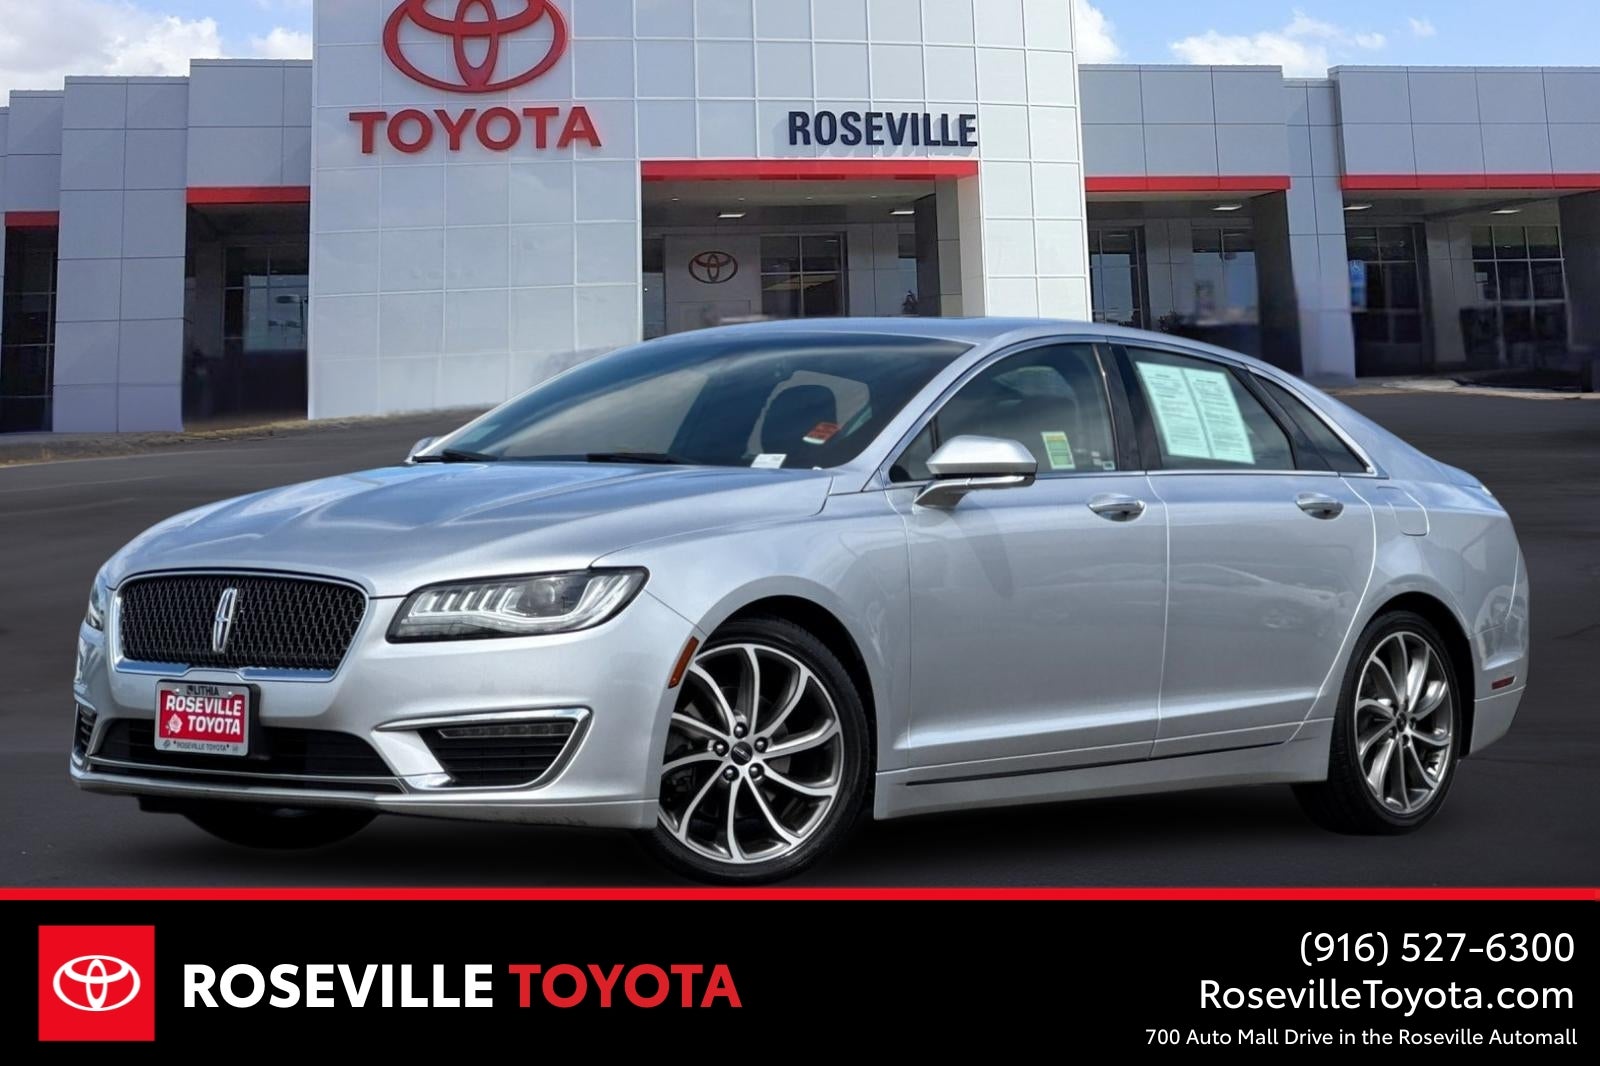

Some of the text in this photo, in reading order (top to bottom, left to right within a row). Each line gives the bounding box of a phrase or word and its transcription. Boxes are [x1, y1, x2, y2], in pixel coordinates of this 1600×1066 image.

[350, 107, 601, 154] TOYOTA
[788, 111, 978, 147] ROSEVILLE
[194, 685, 220, 696] LITHIA
[166, 695, 242, 716] ROSEVILLE
[187, 715, 241, 735] TOYOTA
